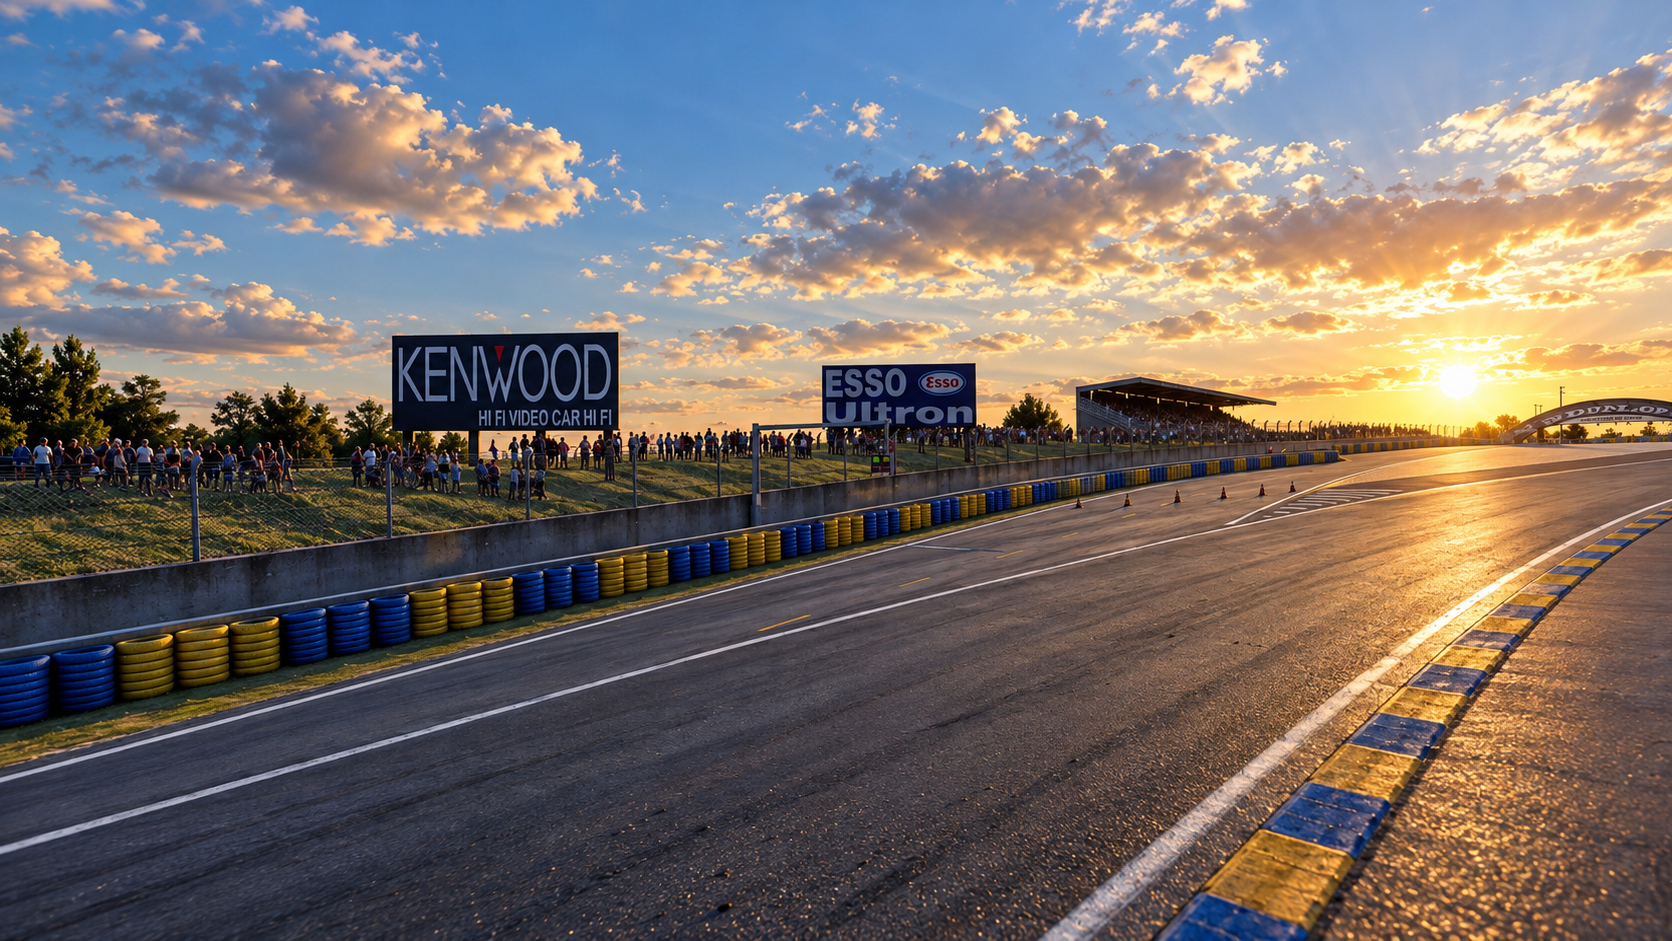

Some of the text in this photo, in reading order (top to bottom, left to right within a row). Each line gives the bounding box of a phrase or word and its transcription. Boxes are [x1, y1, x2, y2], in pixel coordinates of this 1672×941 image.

[398, 343, 612, 403] KENWOOD
[825, 368, 907, 398] ESSO
[925, 376, 959, 389] Esso
[479, 409, 612, 426] HI FI VIDEO CAR HI FI
[826, 401, 973, 424] Ultron
